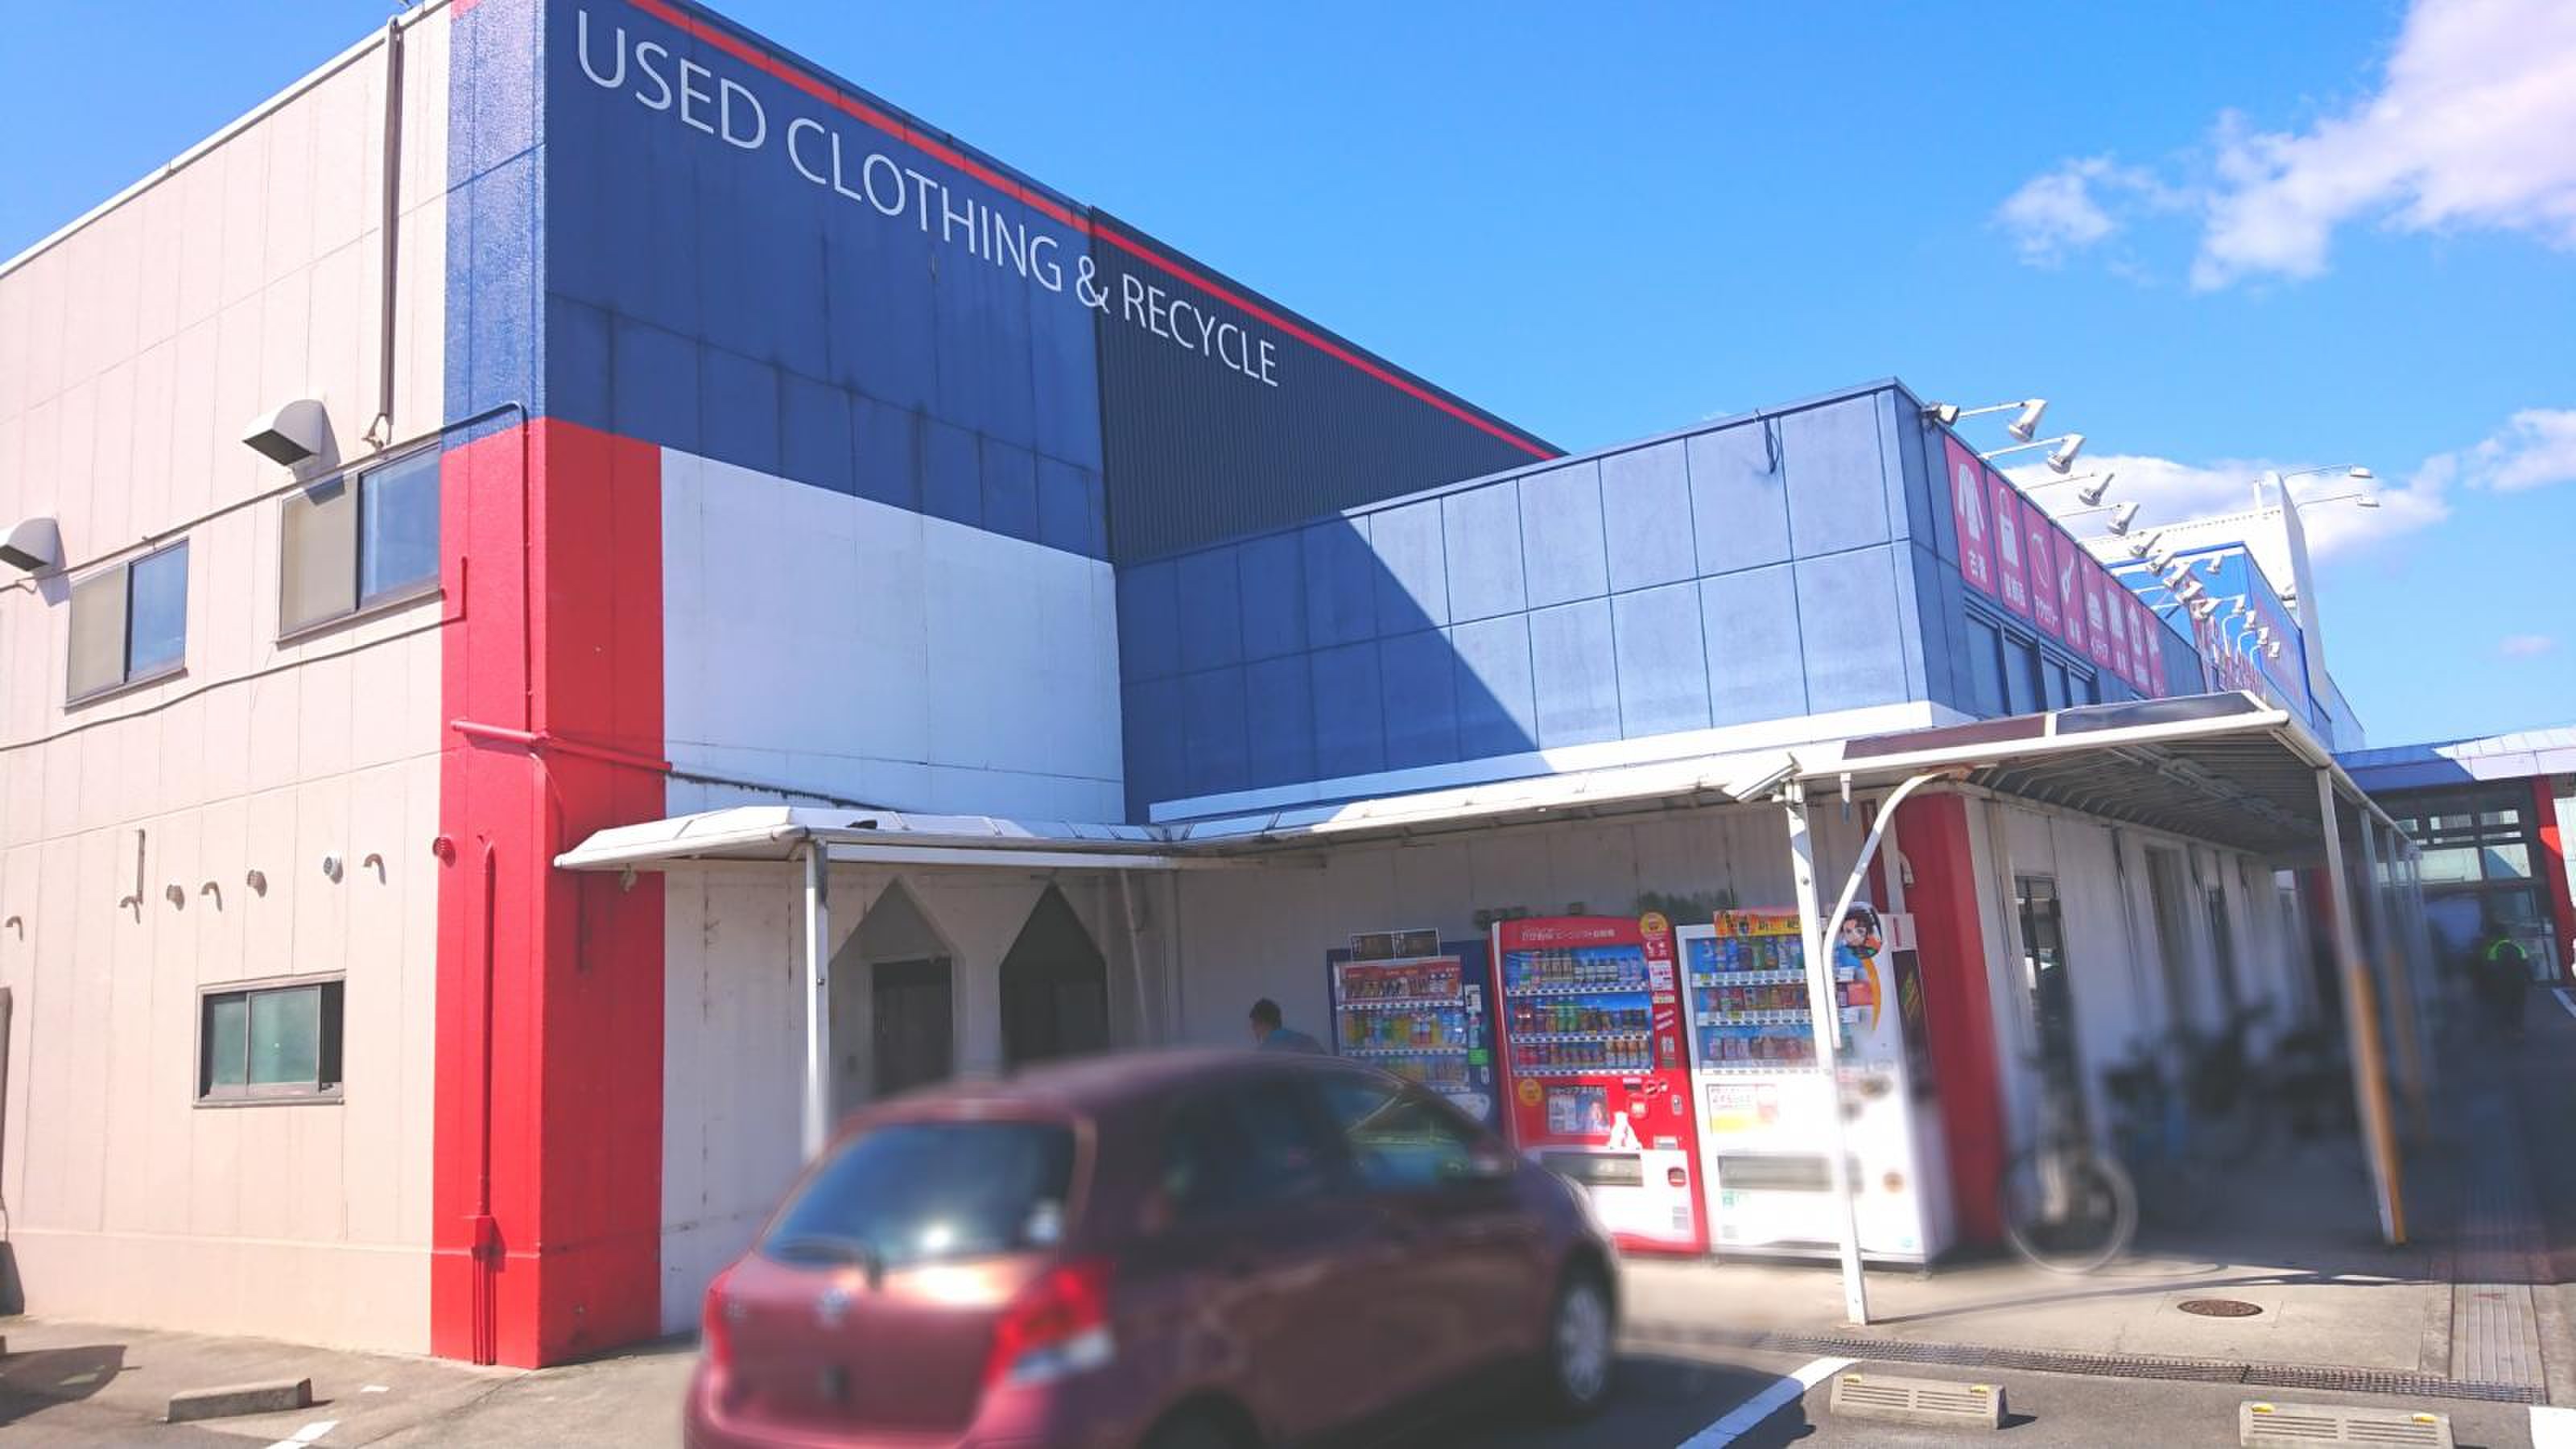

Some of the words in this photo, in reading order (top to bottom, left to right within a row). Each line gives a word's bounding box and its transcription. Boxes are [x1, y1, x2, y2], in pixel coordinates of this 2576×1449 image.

[578, 9, 768, 150] USED
[786, 117, 1063, 292] CLOTHING
[1075, 254, 1111, 315] &
[1122, 273, 1278, 388] RECYCLE
